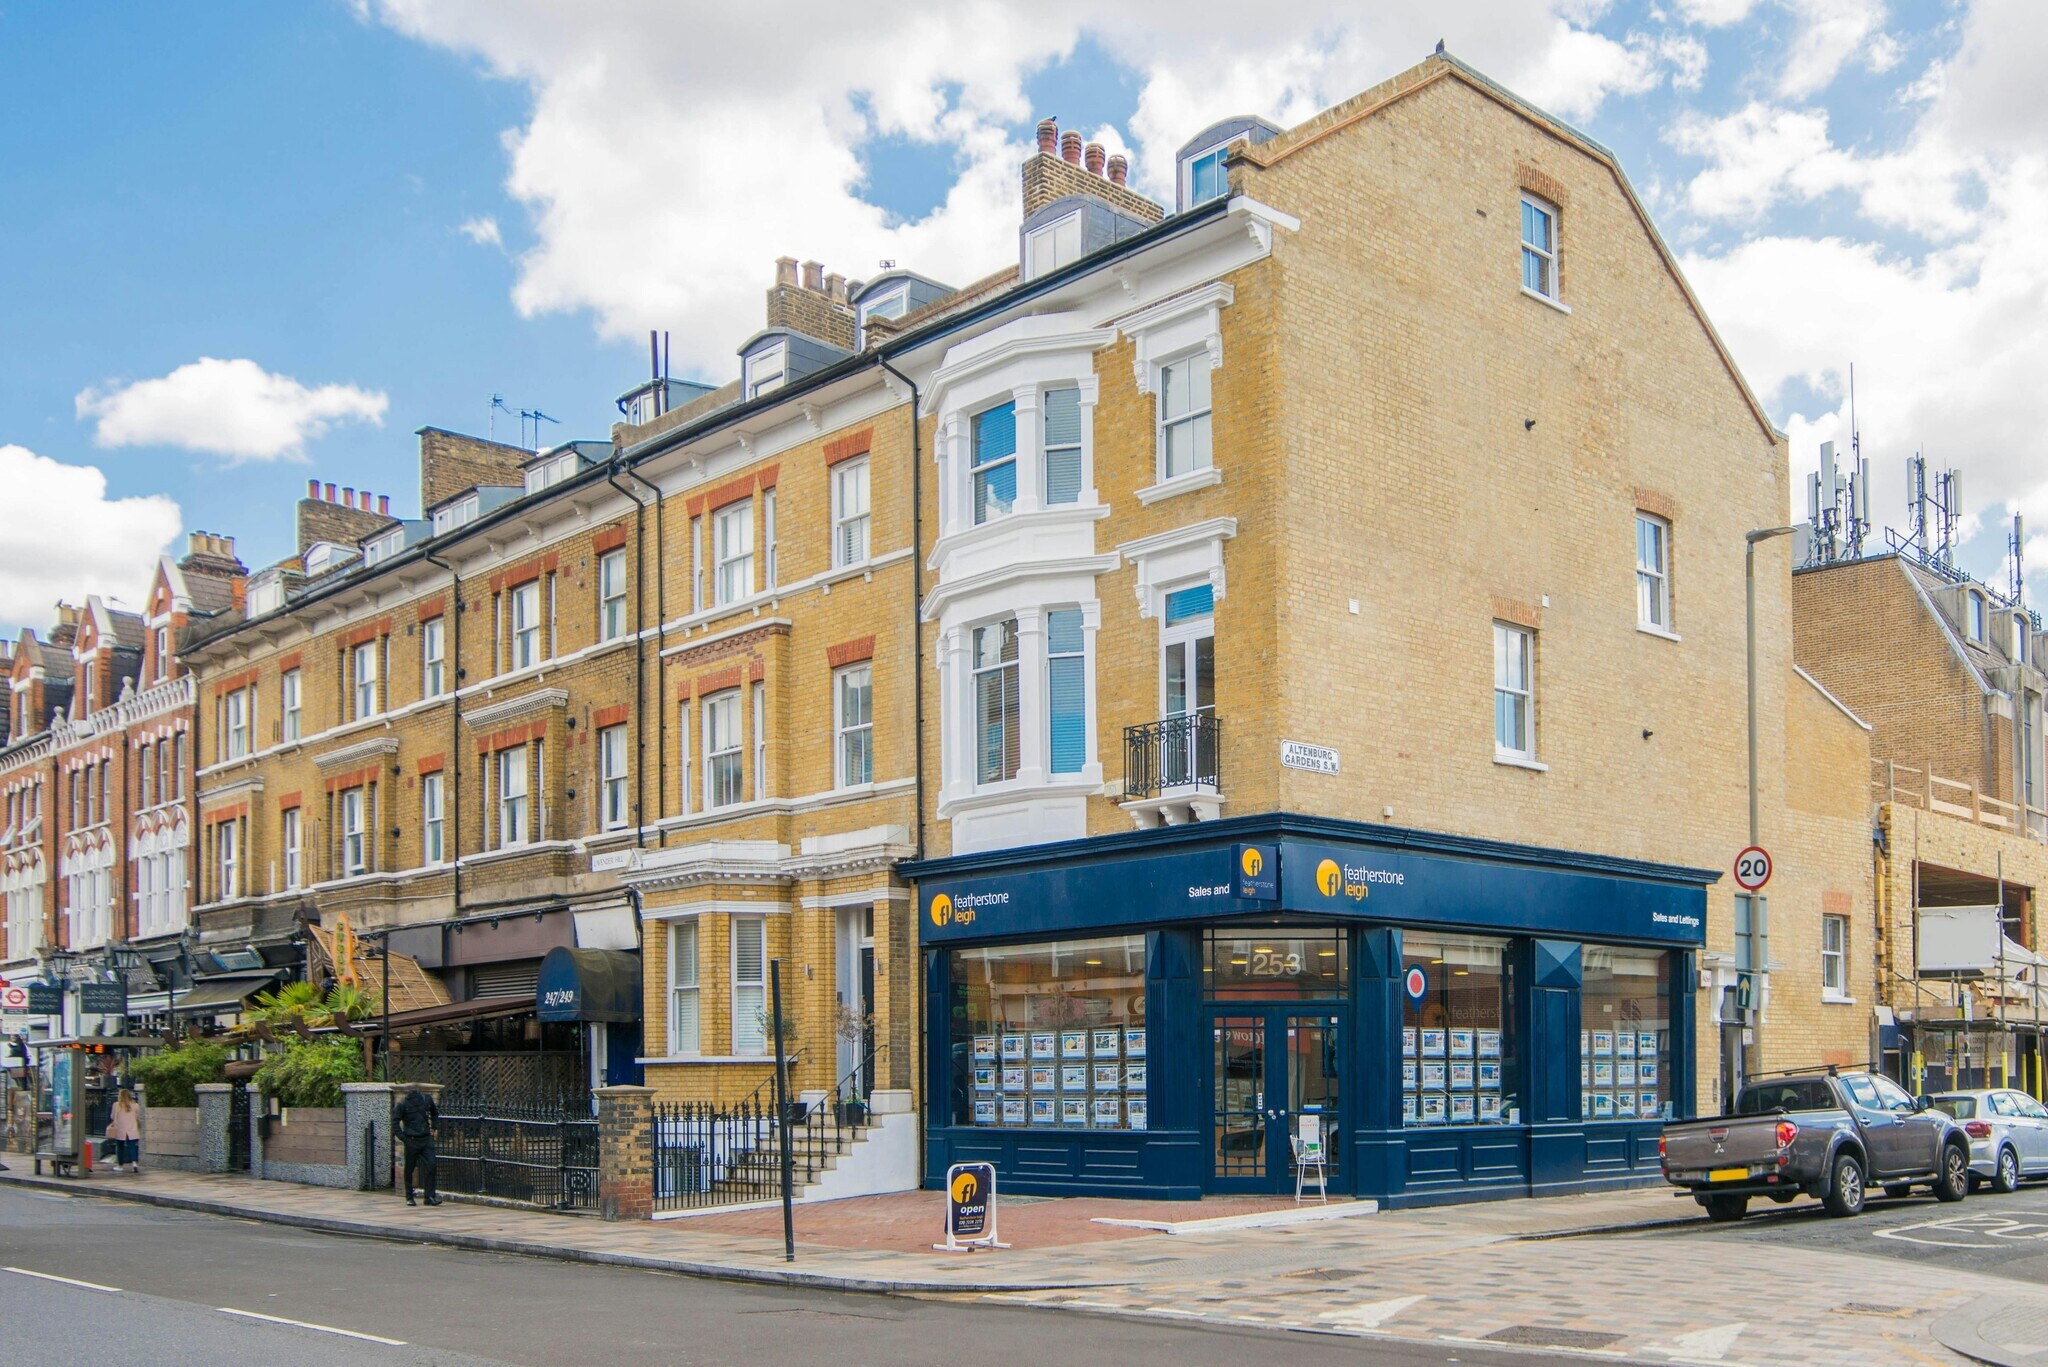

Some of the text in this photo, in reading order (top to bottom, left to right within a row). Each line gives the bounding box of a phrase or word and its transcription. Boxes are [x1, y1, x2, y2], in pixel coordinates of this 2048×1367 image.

[1289, 744, 1333, 760] ALTENBURG
[1285, 754, 1321, 769] GARDENS
[1343, 863, 1404, 885] featherstone
[1740, 859, 1767, 877] 20
[1188, 883, 1230, 898] Sales and
[1242, 878, 1274, 889] featherstone
[1344, 880, 1369, 902] leigh
[954, 892, 1009, 908] featherstone
[1242, 887, 1256, 897] leigh
[954, 907, 976, 926] leigh
[1652, 911, 1700, 928] Sales and Lettings
[1253, 953, 1301, 976] 253
[544, 987, 574, 1007] 247/249
[960, 1205, 985, 1215] open
